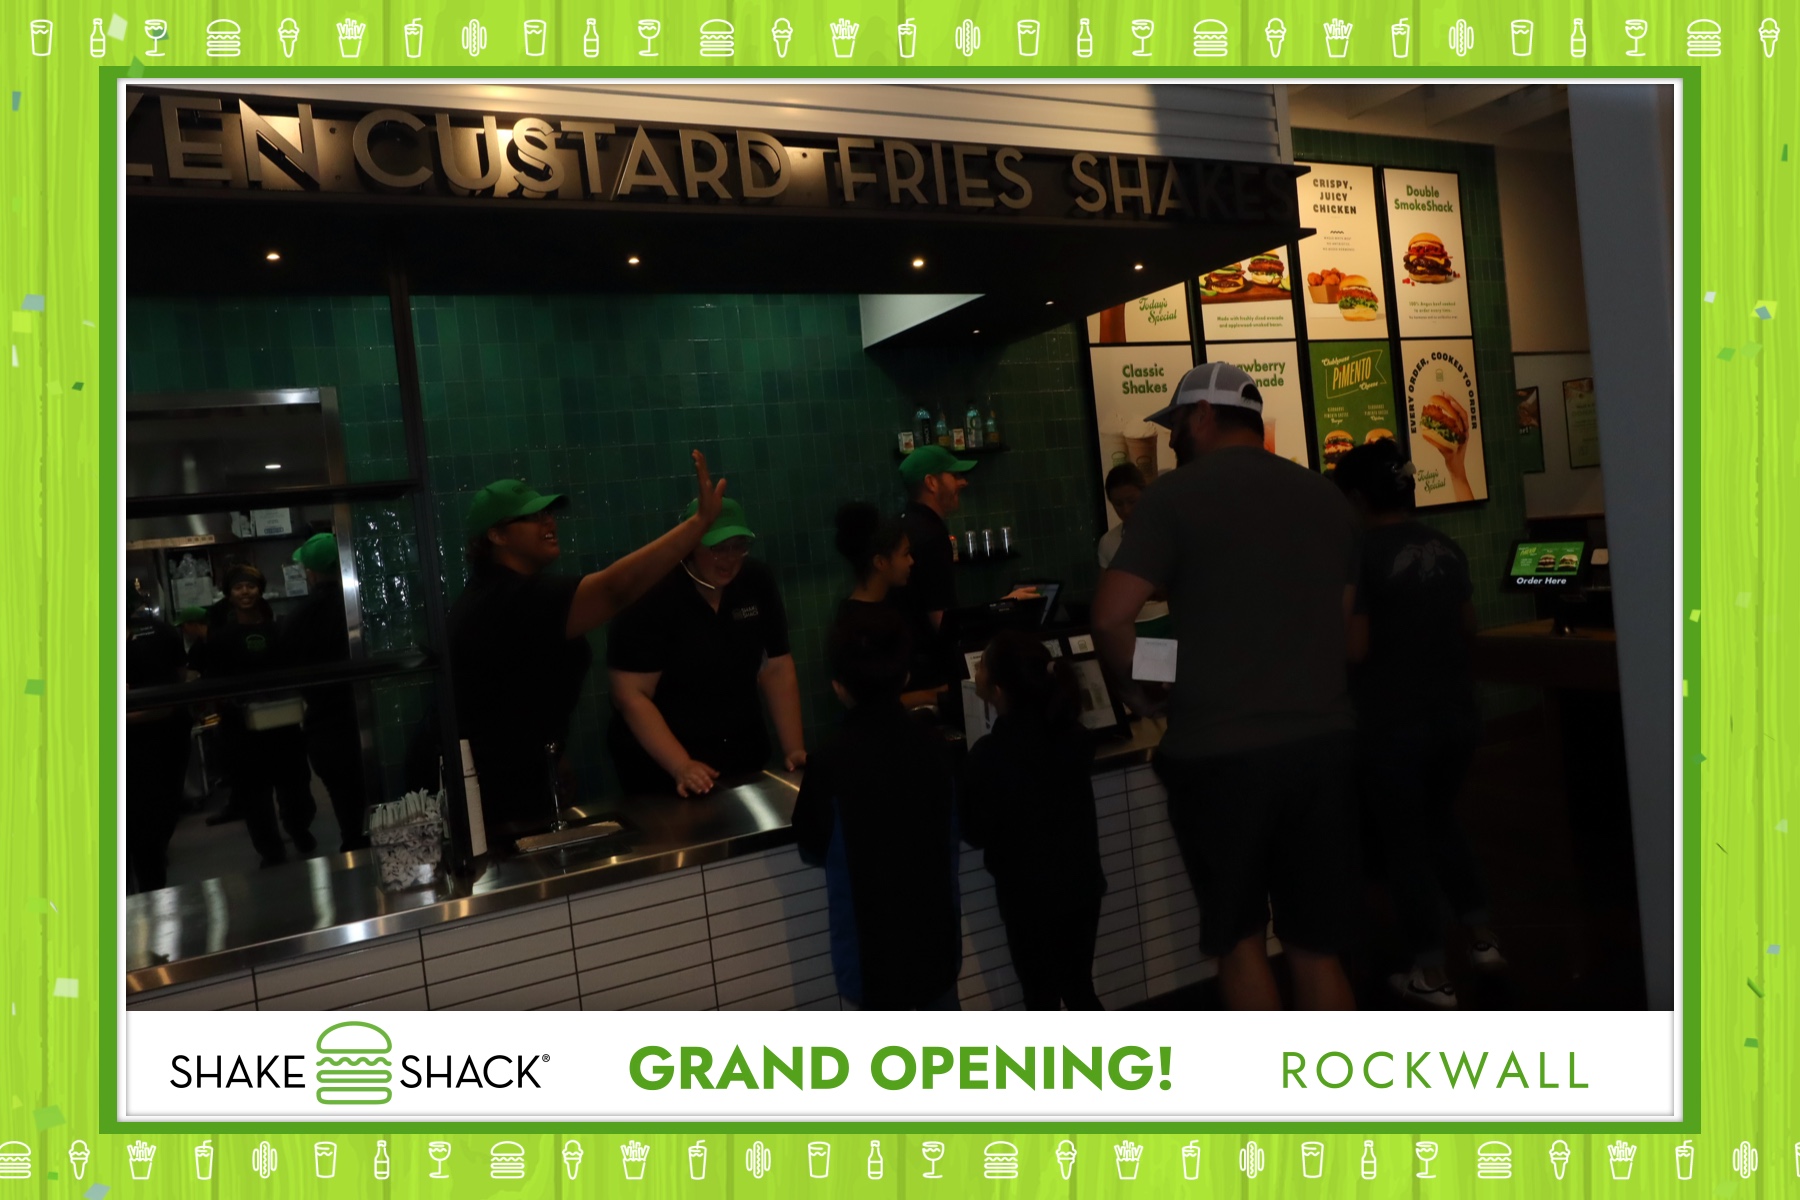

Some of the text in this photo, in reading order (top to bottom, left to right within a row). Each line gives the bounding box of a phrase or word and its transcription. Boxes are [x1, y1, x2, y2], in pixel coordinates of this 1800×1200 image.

[352, 108, 791, 199] CUSTARD
[836, 137, 1033, 210] FRIES
[1071, 152, 1293, 220] SHAKES
[1312, 178, 1353, 190] CRISPY,
[1406, 184, 1440, 198] Double
[1319, 191, 1348, 202] JUICY
[1312, 204, 1357, 215] CHICKEN
[1394, 198, 1454, 213] SmokeShack
[1147, 309, 1177, 326] Special
[1122, 363, 1165, 378] Classic
[1122, 381, 1167, 395] Shakes
[1255, 373, 1285, 388] nade
[1408, 351, 1478, 434] EVERY ORDER, COOKED TO ORDER
[1424, 478, 1446, 494] Special
[1516, 576, 1567, 585] Order Here
